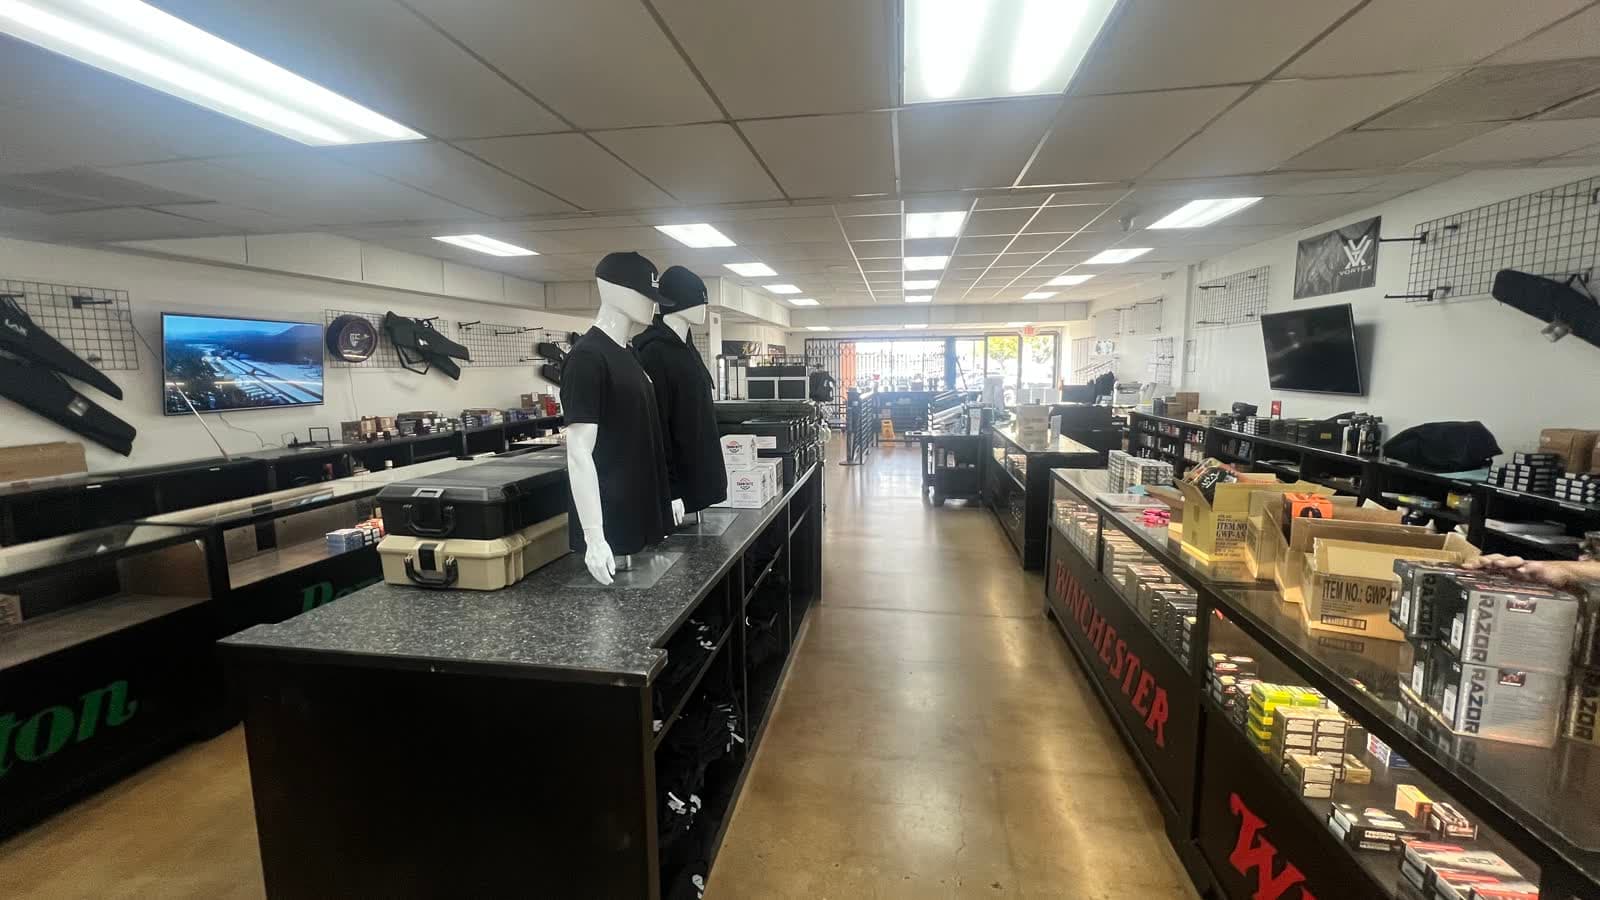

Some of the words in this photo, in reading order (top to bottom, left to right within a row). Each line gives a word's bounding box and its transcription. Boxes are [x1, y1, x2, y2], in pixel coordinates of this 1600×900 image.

[1322, 580, 1344, 600] ITEM
[1056, 559, 1169, 748] WINCHESTER
[1472, 594, 1495, 663] RAZOR
[1463, 668, 1487, 734] RAZOR
